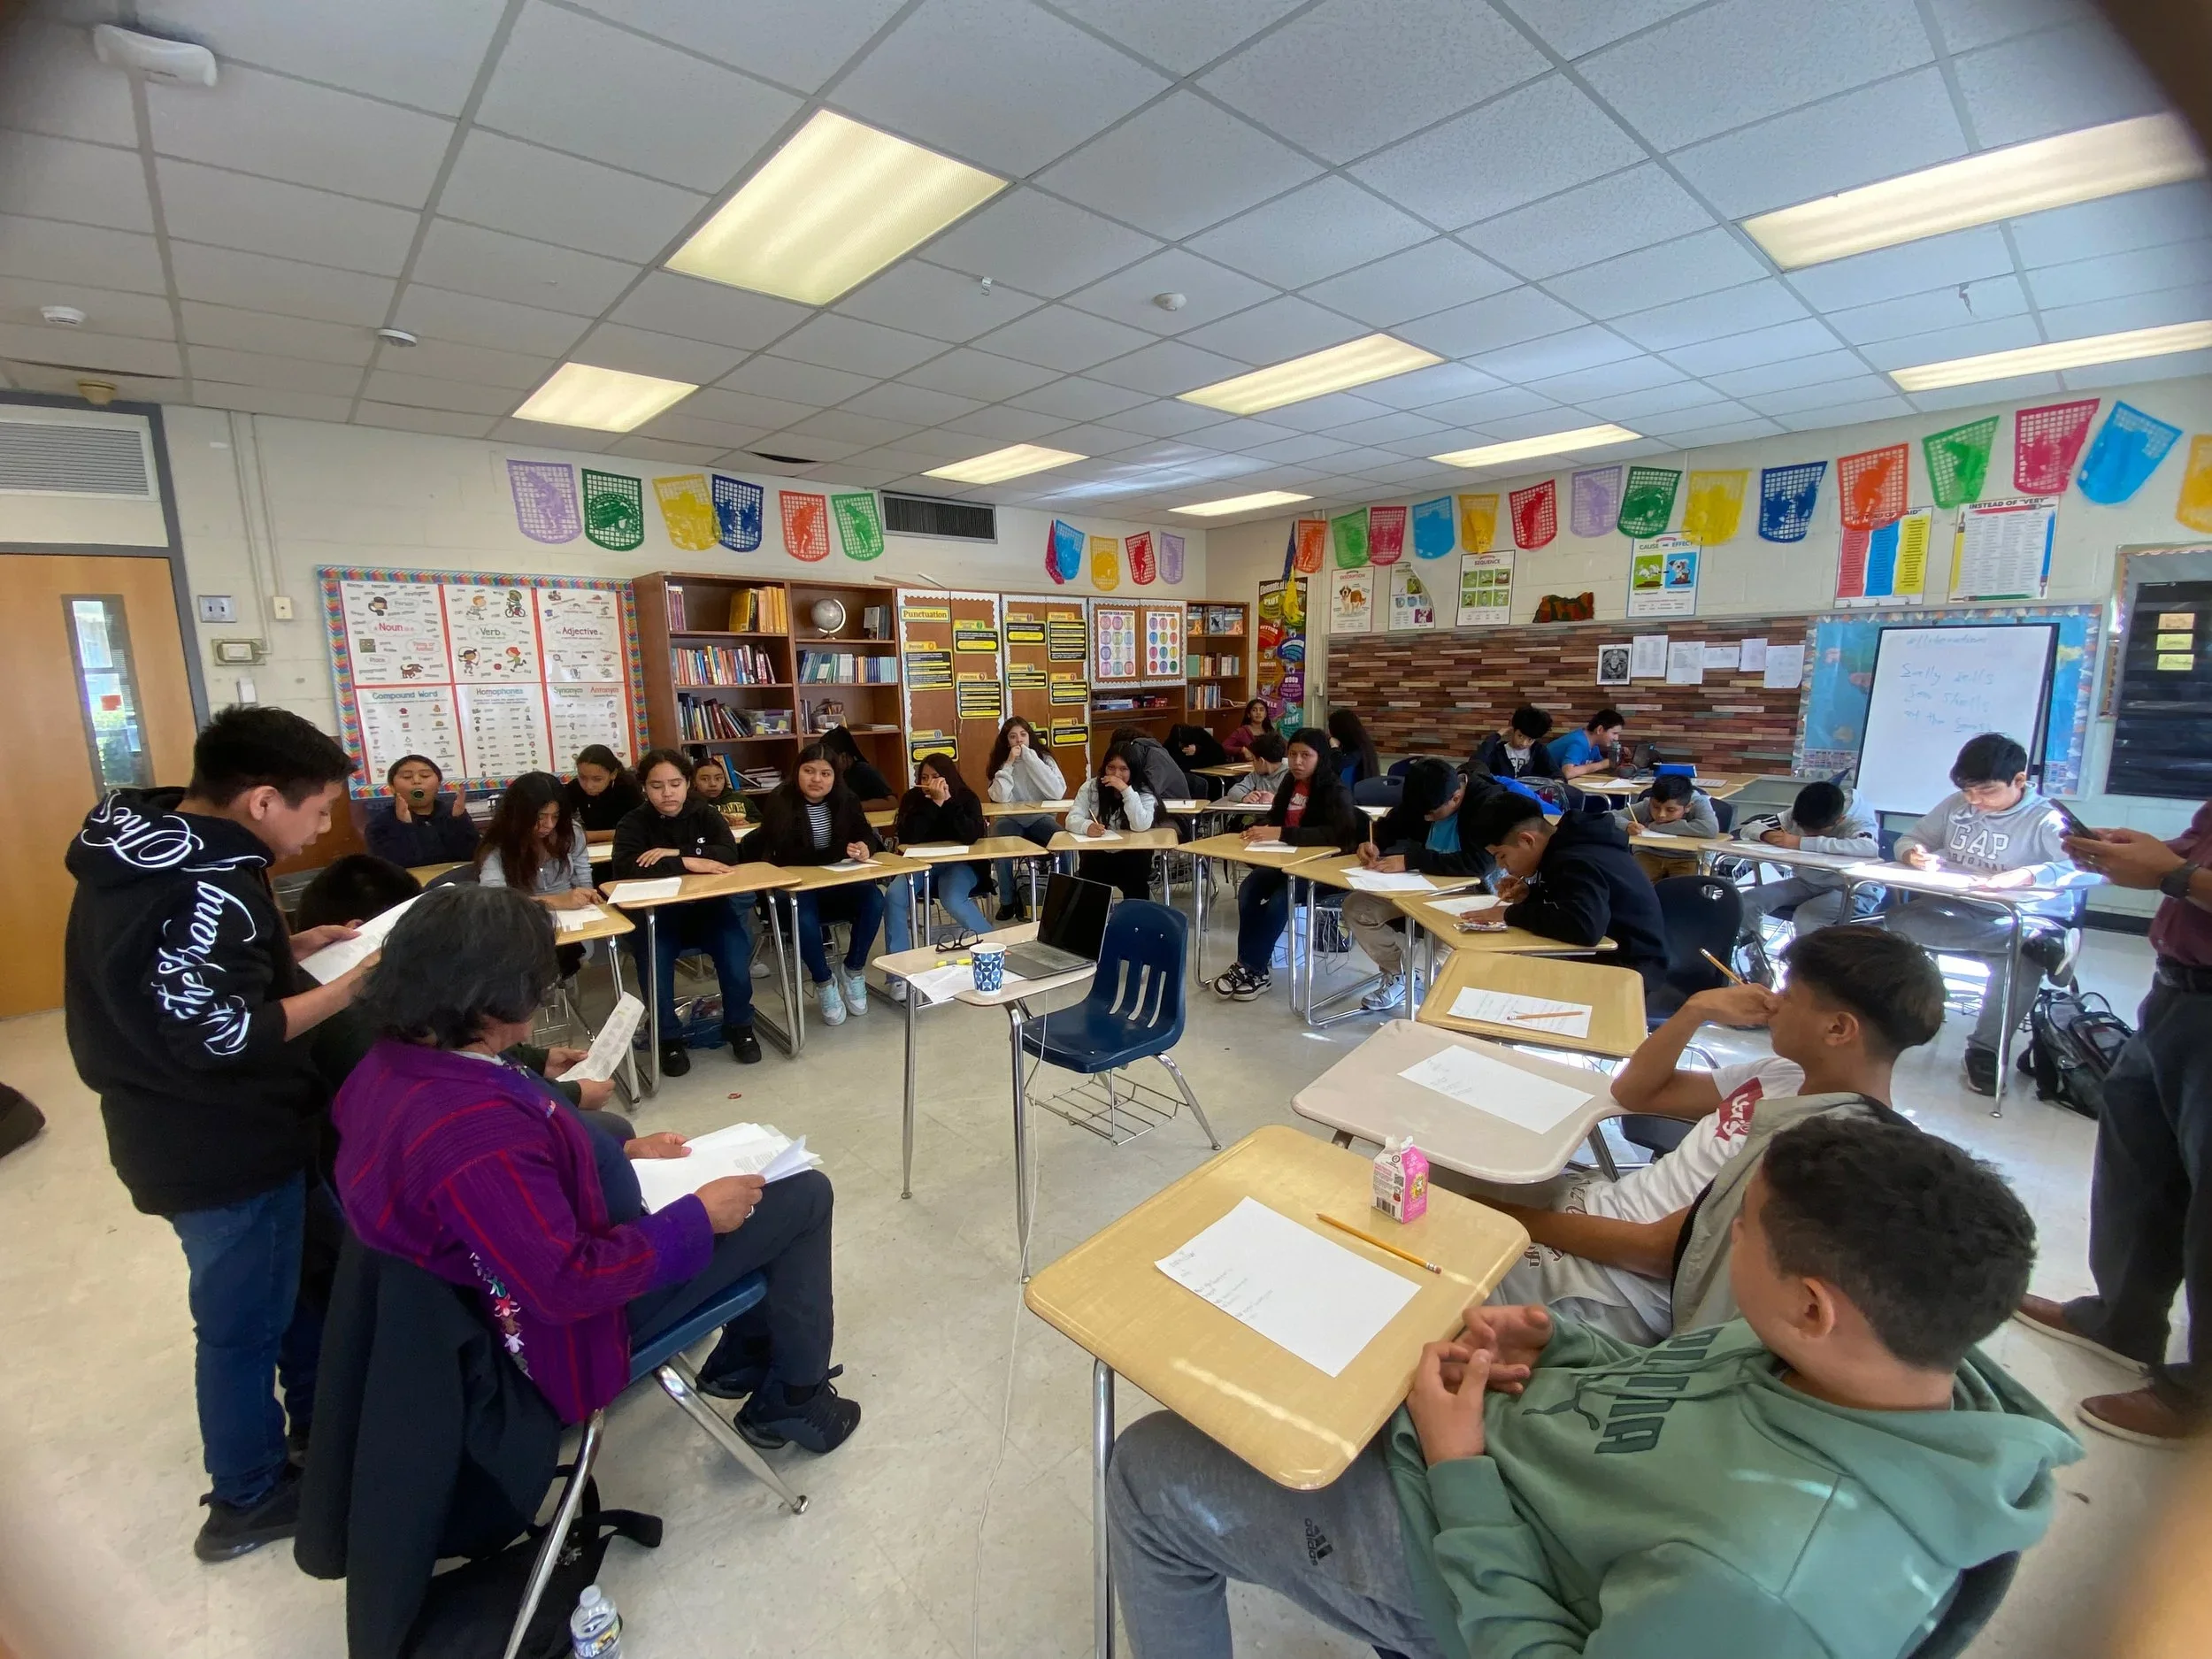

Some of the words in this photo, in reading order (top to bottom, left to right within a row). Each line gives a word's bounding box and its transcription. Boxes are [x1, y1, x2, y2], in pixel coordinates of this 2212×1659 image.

[1263, 595, 1279, 606] PLOT
[902, 610, 948, 618] Punctuation
[379, 622, 403, 632] Noun
[480, 627, 501, 636] Verb
[562, 626, 598, 637] Adjective
[476, 687, 524, 696] Homophones
[553, 687, 584, 695] Synonym
[1284, 712, 1300, 726] TONE
[1949, 824, 2010, 861] GAP
